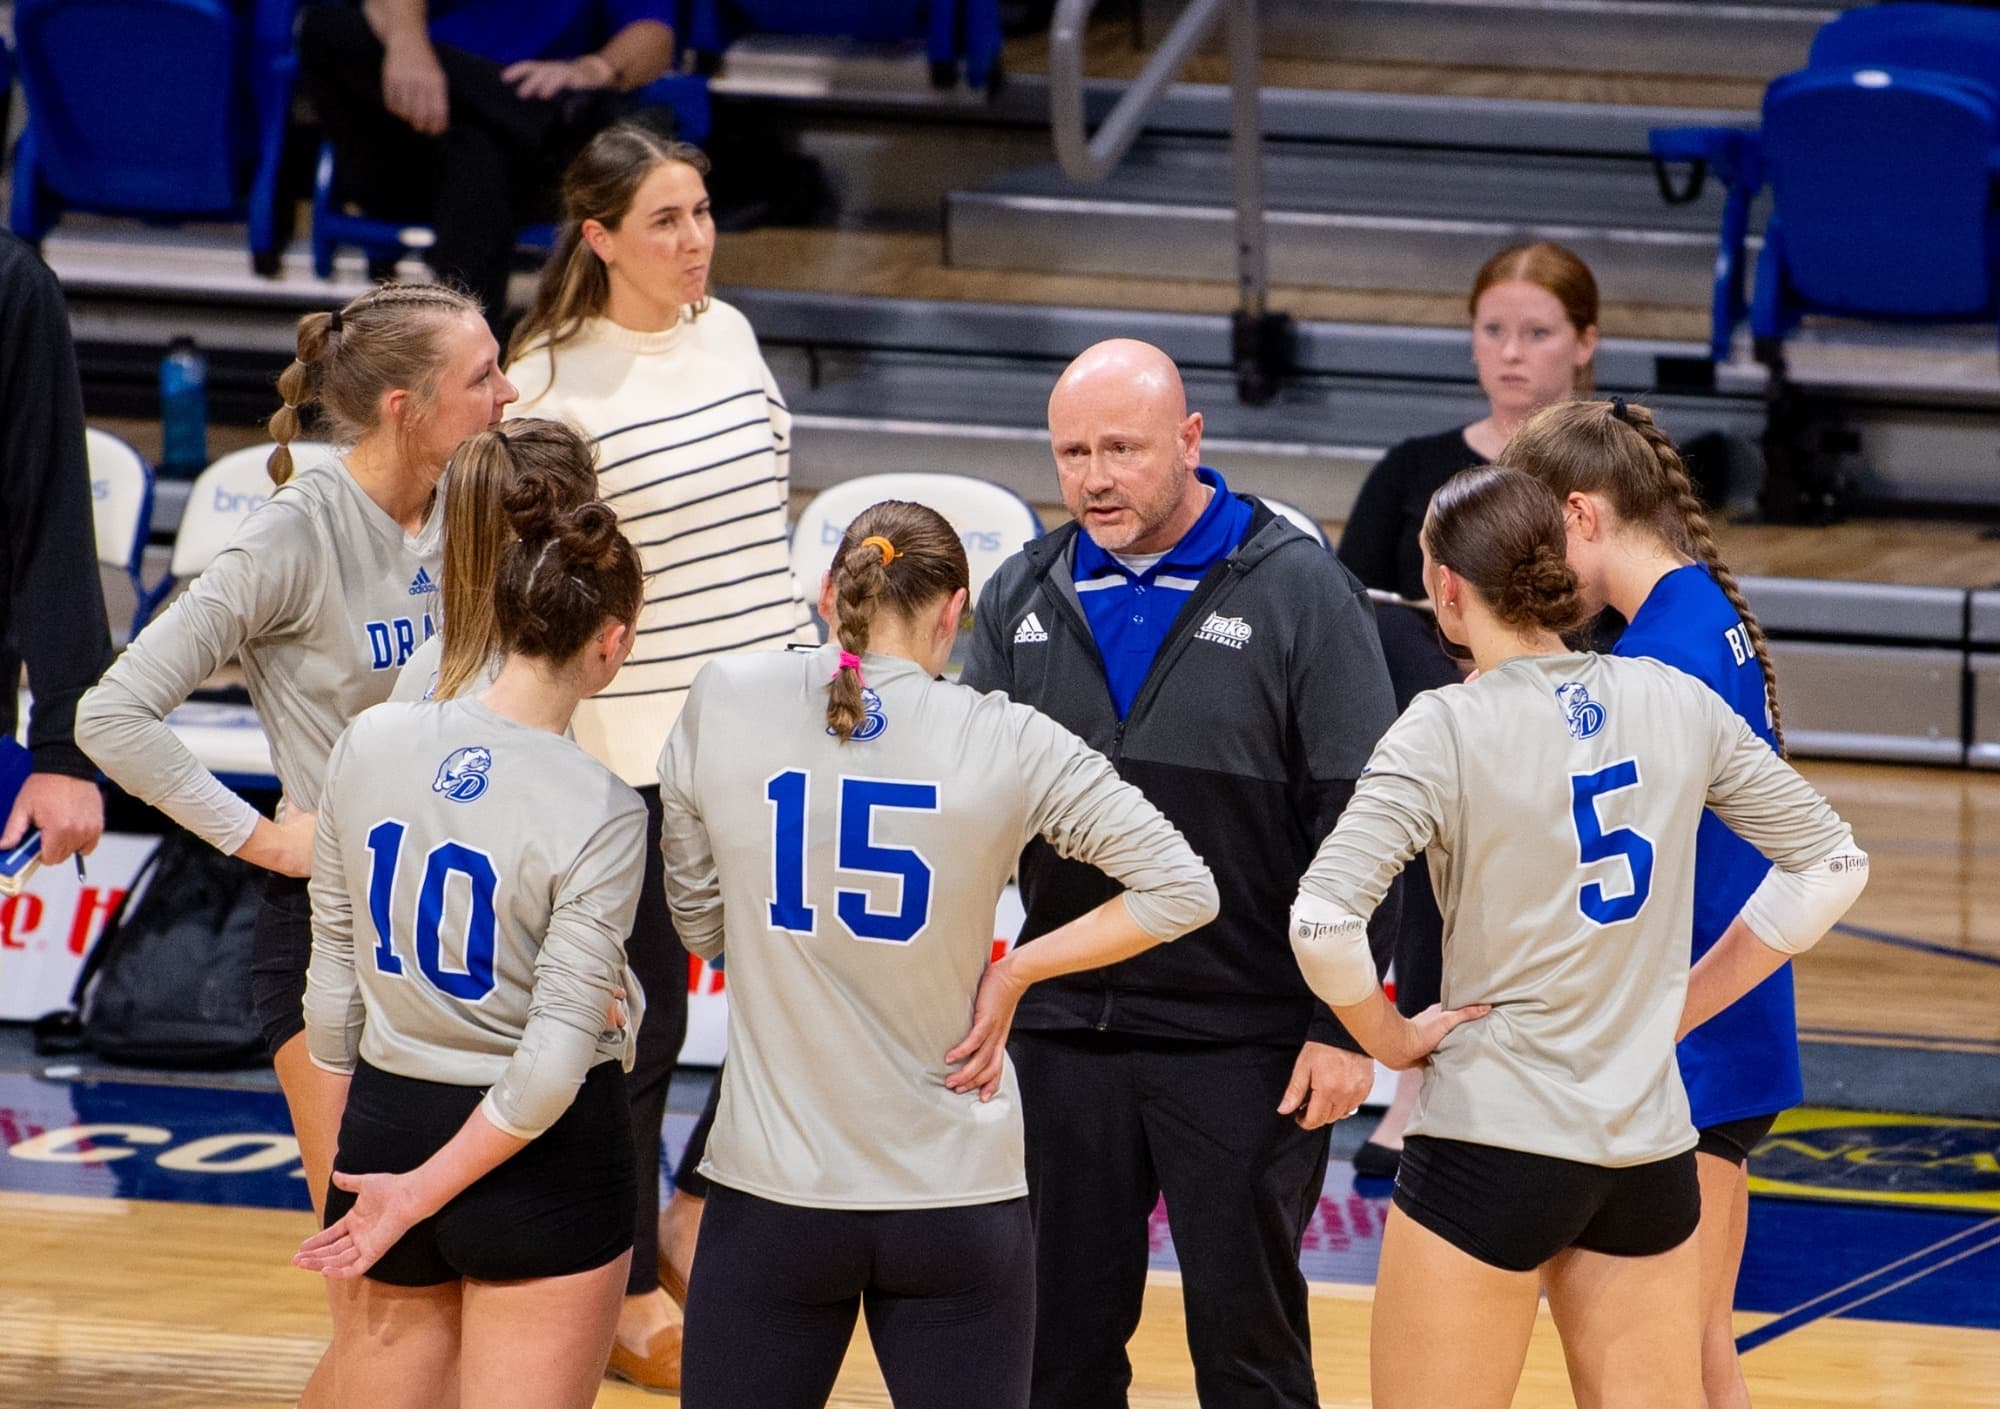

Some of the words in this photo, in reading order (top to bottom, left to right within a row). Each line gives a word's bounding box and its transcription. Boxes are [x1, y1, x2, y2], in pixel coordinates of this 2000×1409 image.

[365, 816, 501, 1005] 10
[764, 766, 941, 946] 15
[1568, 755, 1657, 928] 5
[9, 1123, 308, 1179] CO
